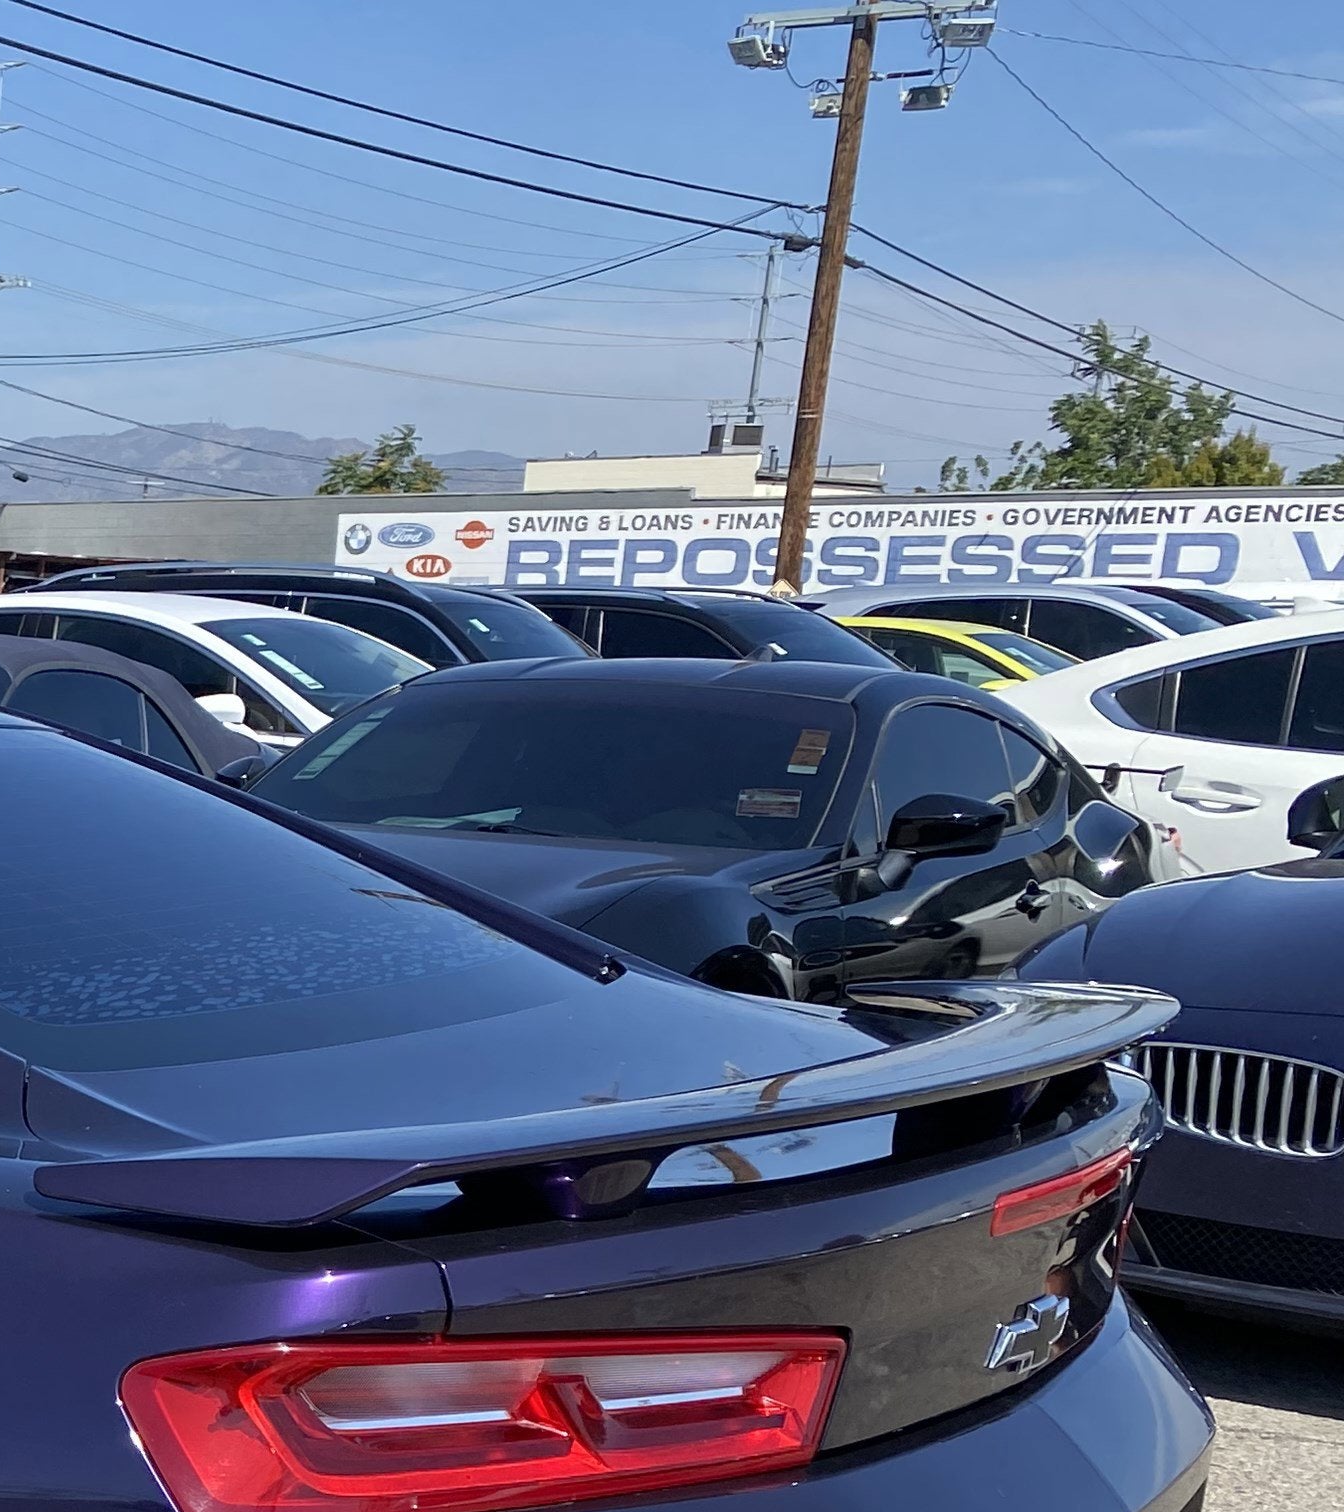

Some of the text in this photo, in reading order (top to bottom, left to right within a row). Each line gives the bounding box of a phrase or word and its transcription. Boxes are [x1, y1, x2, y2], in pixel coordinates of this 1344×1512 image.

[507, 503, 1344, 533] SAVING & LOANS FINANE COMPANIES GOVERNMENT AGENCIES
[389, 527, 423, 544] Ford
[456, 530, 494, 540] NISSAN
[412, 558, 446, 574] KIA
[504, 531, 1240, 587] REPOSSESSED
